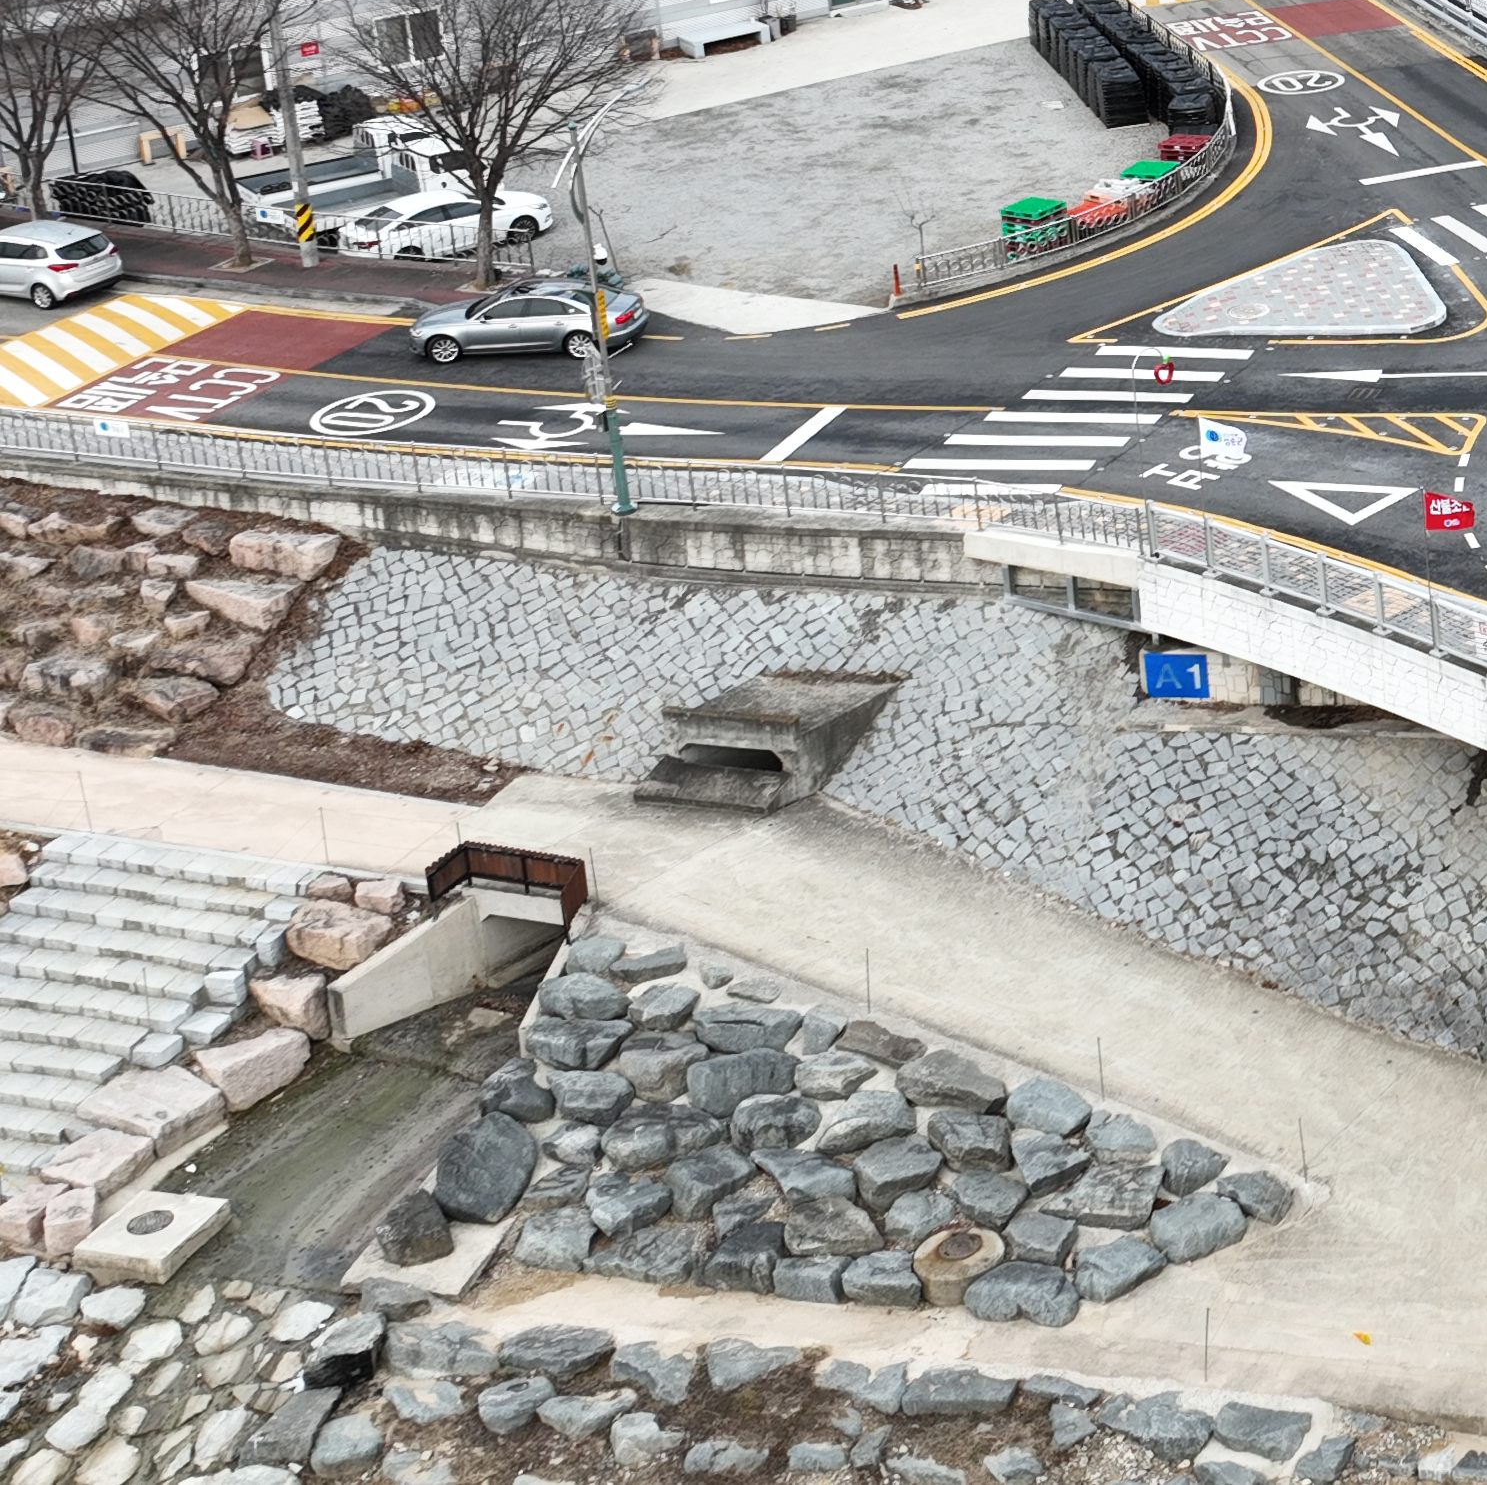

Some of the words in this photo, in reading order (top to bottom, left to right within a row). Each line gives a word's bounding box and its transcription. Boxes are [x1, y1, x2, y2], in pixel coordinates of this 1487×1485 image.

[1191, 26, 1293, 52] CCTV
[144, 366, 282, 422] CCTV
[1155, 662, 1202, 690] A1
